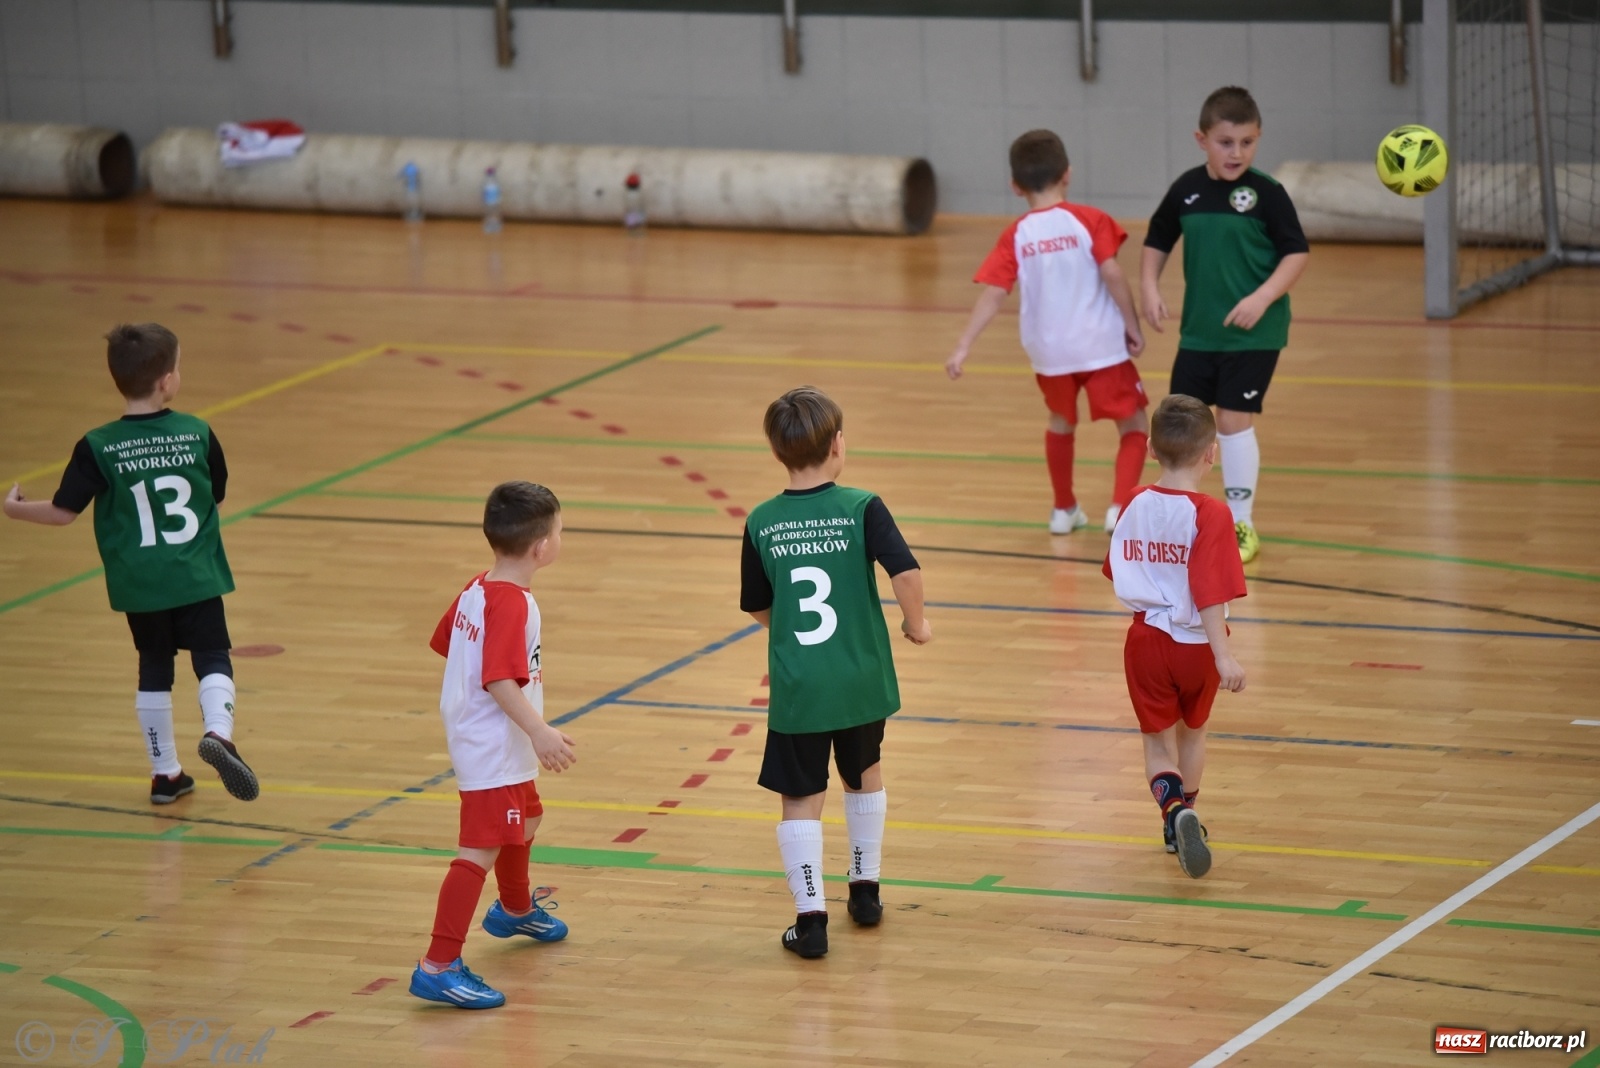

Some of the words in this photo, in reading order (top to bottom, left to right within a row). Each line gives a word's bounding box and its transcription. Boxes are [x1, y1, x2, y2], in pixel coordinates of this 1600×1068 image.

[1037, 234, 1078, 254] CIESZYN
[103, 438, 151, 453] AKADEMIA
[118, 445, 164, 459] MŁODEGO
[114, 451, 197, 474] TWORKÓW
[129, 474, 199, 547] 13
[759, 521, 804, 537] AKADEMIA
[805, 518, 856, 528] PIŁKARSKA
[771, 530, 817, 542] MŁODEGO
[818, 529, 843, 537] LKS-u
[769, 537, 850, 559] TWORKÓW
[790, 566, 838, 646] 3
